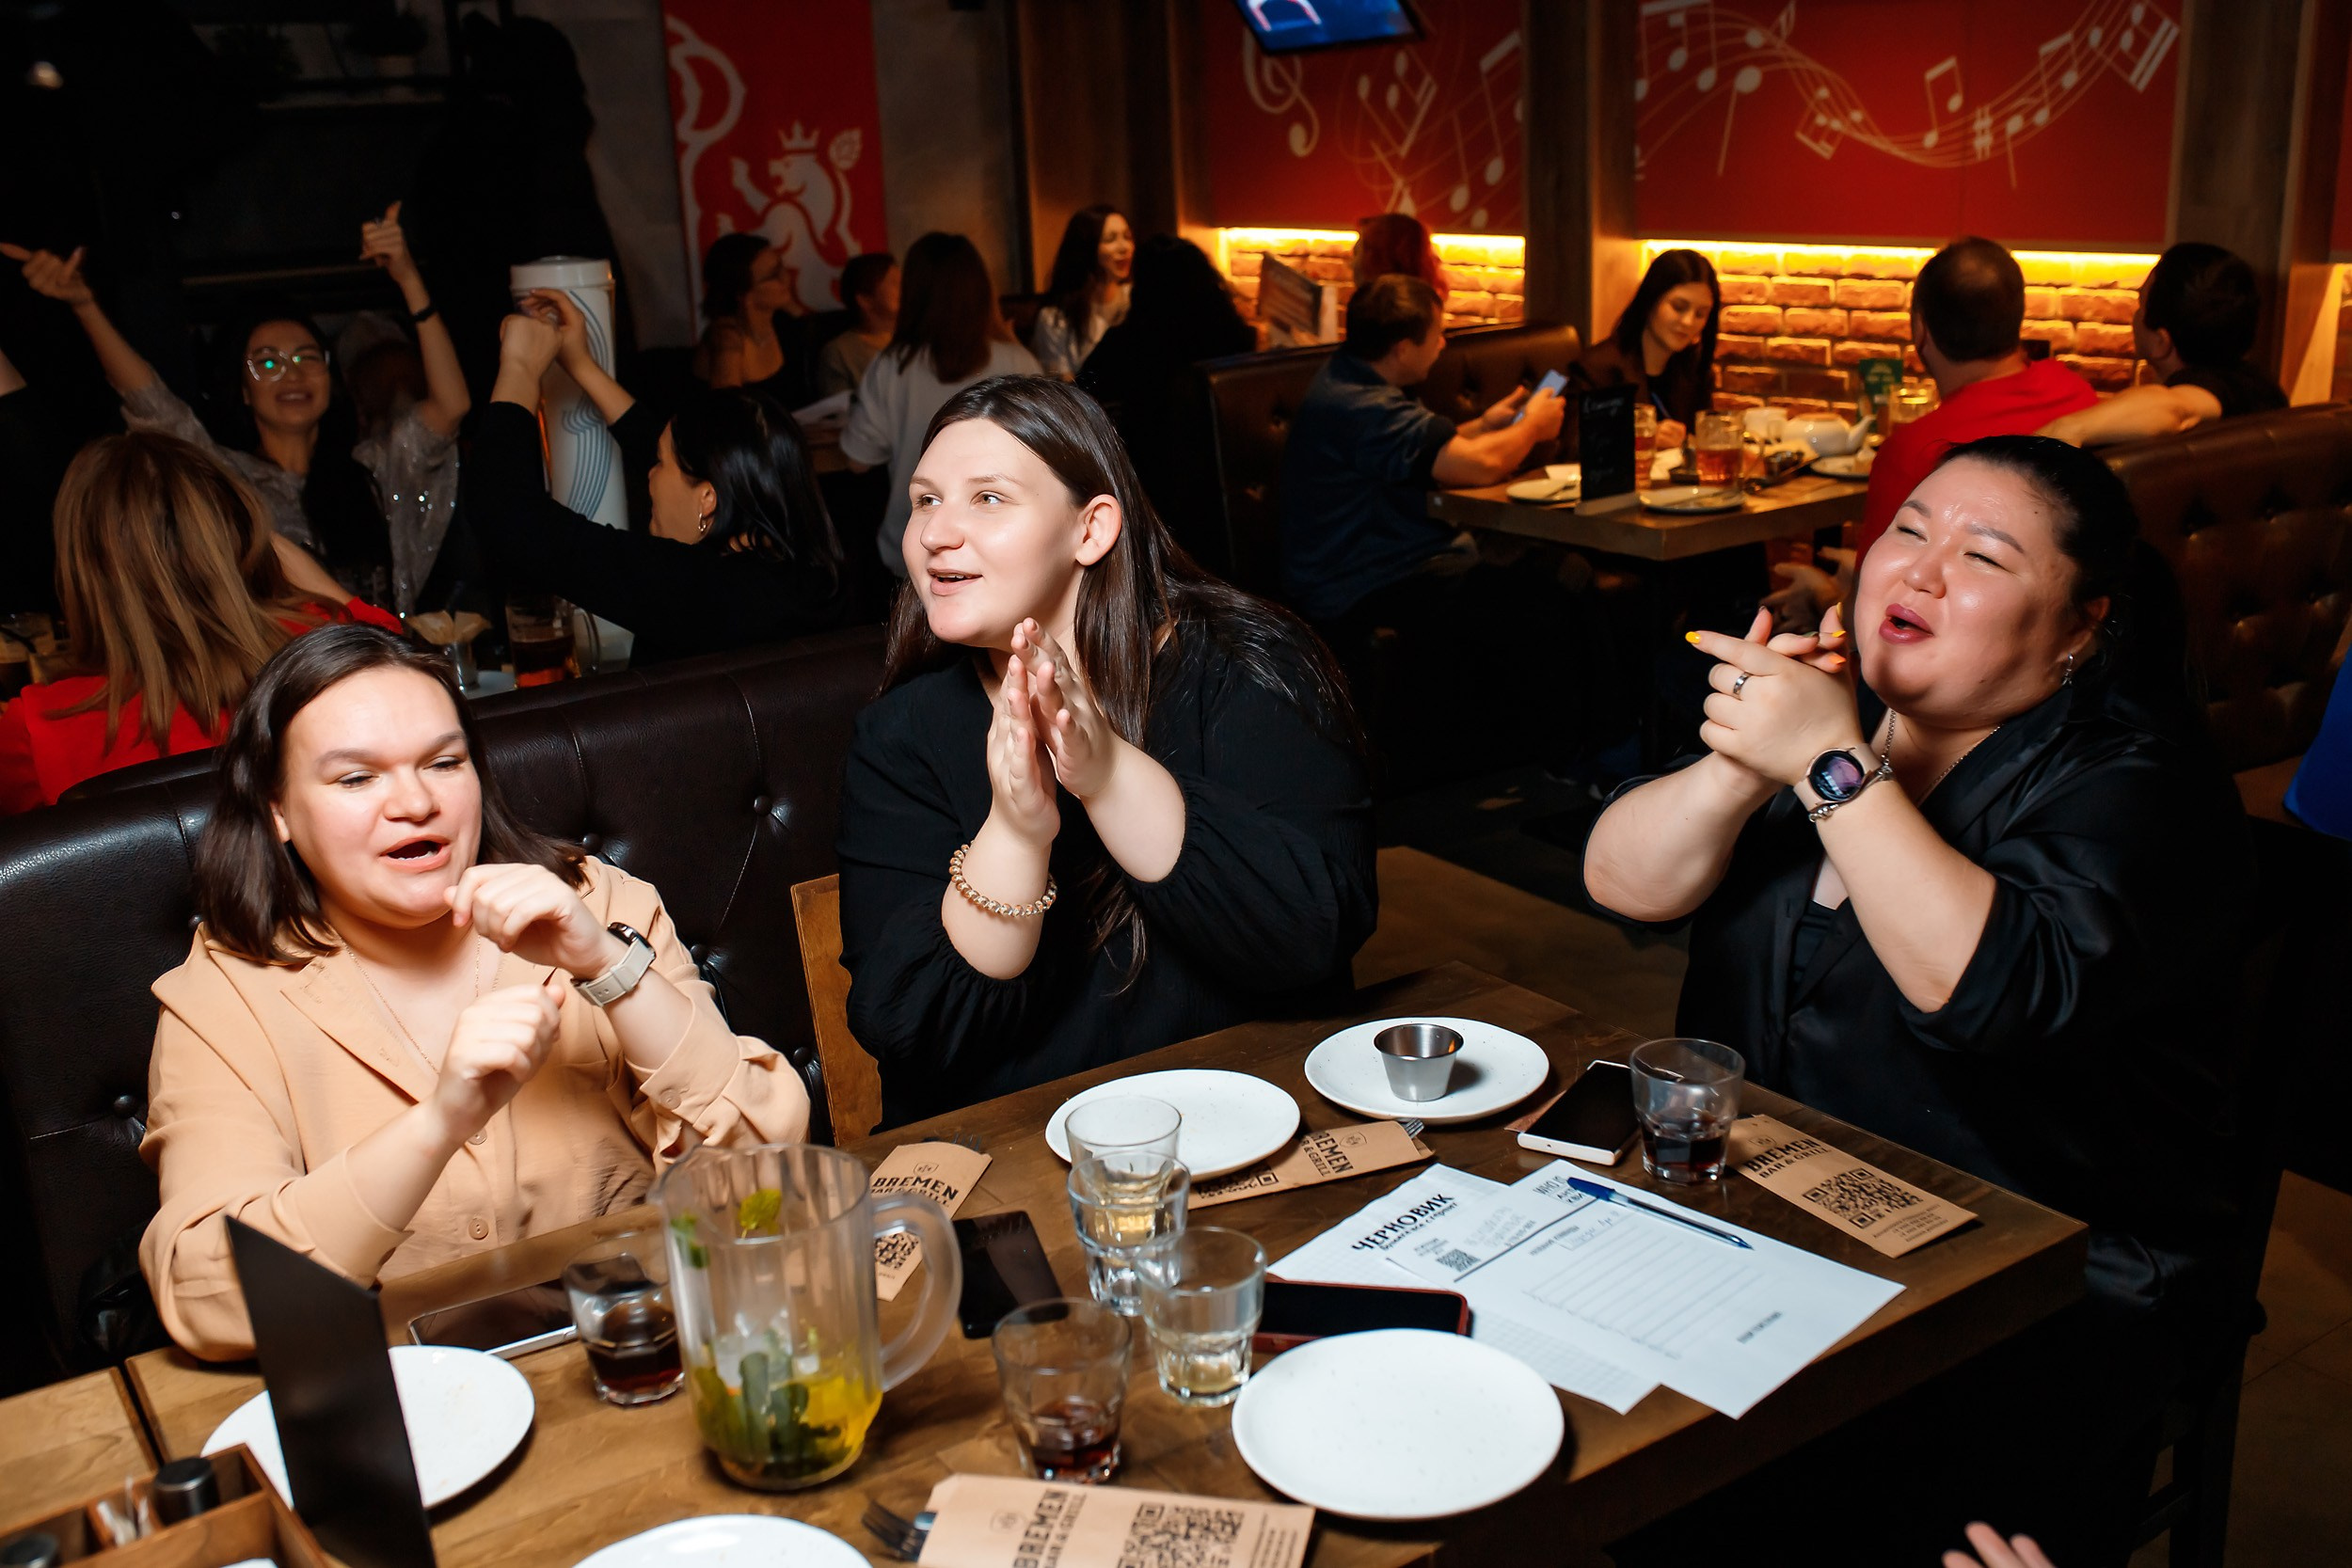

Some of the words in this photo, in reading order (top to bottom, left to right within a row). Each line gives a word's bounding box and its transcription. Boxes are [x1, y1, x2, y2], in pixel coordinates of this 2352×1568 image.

[1311, 1132, 1354, 1174] REMEN
[1743, 1138, 1821, 1172] BREMEN
[1758, 1163, 1786, 1179] BAR
[1794, 1148, 1832, 1161] GRILL
[873, 1177, 959, 1200] BREMEN
[1352, 1194, 1454, 1250] ЧЕРНОВИК
[1012, 1489, 1069, 1568] BREMEN
